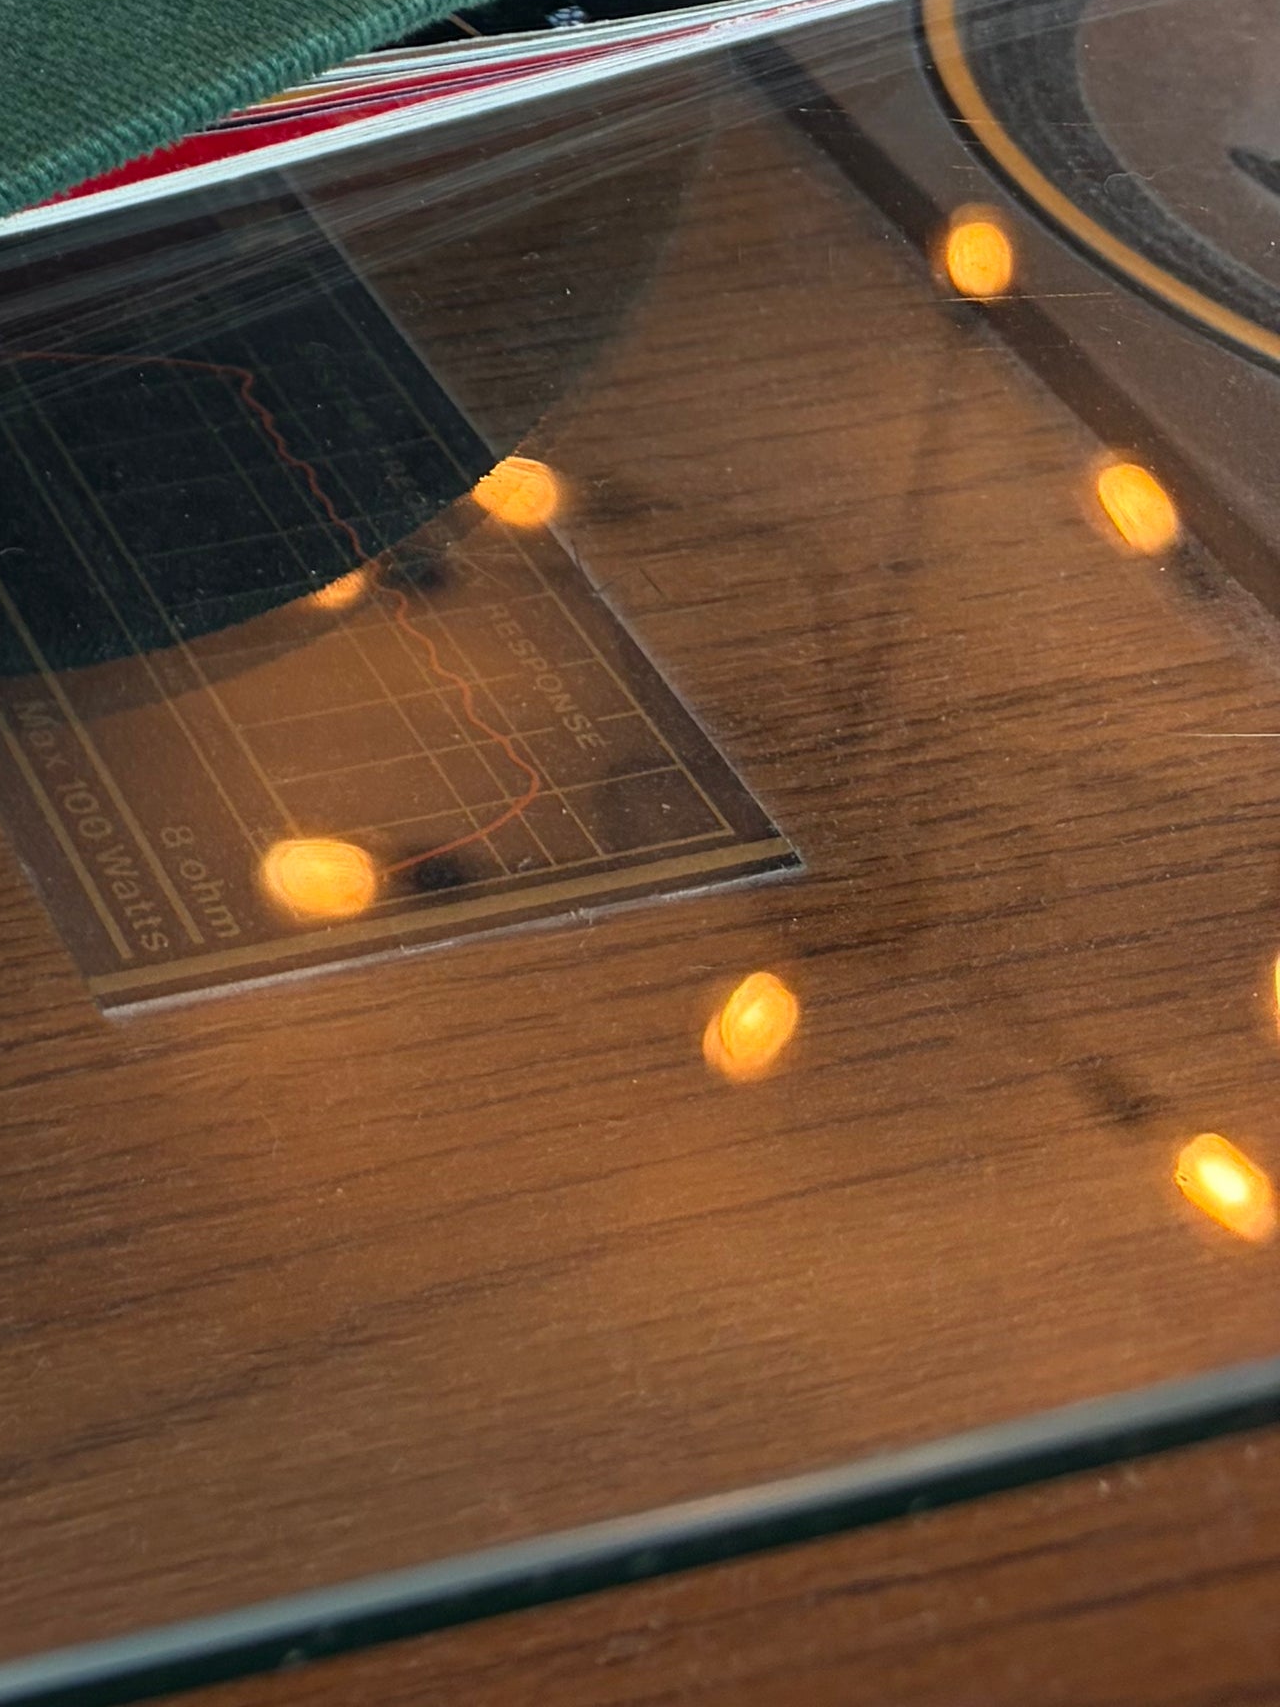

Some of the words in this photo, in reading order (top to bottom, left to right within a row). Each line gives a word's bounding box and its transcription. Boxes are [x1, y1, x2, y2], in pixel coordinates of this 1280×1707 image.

[486, 602, 603, 747] RESPONSE
[12, 699, 69, 770] Max
[56, 778, 113, 839] 100
[96, 845, 169, 951] Watts
[160, 825, 196, 848] 8
[180, 859, 240, 938] ohm
